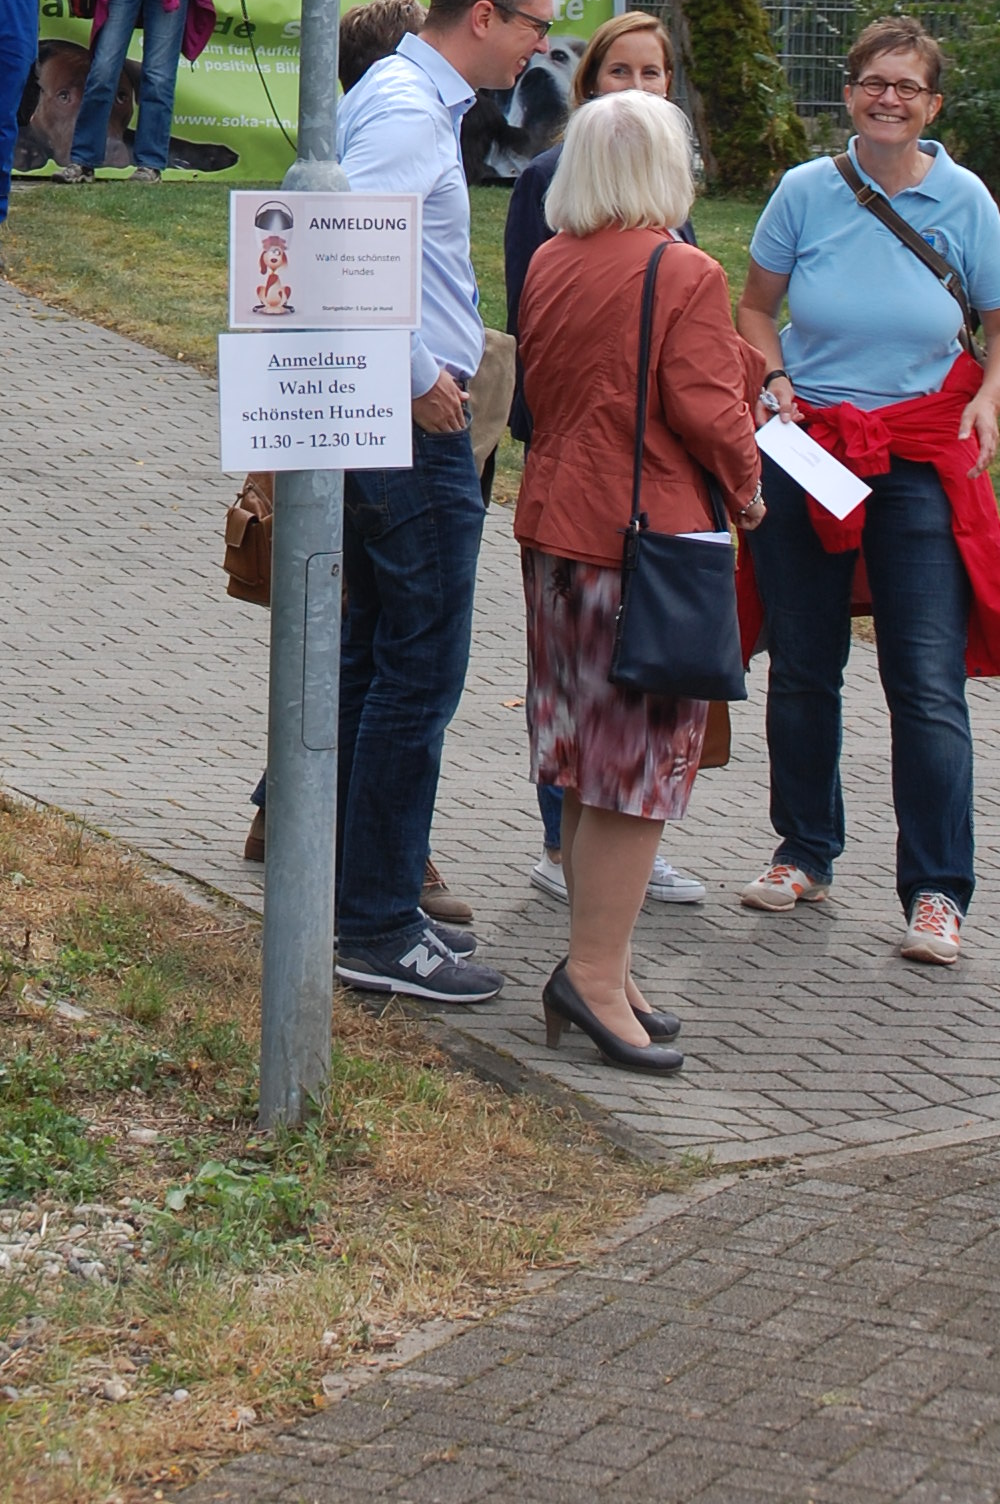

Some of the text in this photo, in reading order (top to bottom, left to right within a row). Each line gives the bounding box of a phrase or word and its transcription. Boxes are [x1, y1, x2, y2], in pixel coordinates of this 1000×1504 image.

[255, 45, 300, 58] Aufkl
[309, 217, 407, 231] ANMELDUNG
[315, 253, 401, 262] Wahl des schönsten
[342, 267, 375, 276] Hundes
[267, 352, 367, 370] Anmeldung
[279, 379, 356, 395] Wahl des
[242, 404, 393, 422] schönsten Hundes
[250, 434, 292, 449] 11.30
[310, 433, 350, 447] 12.30
[355, 432, 387, 446] Uhr
